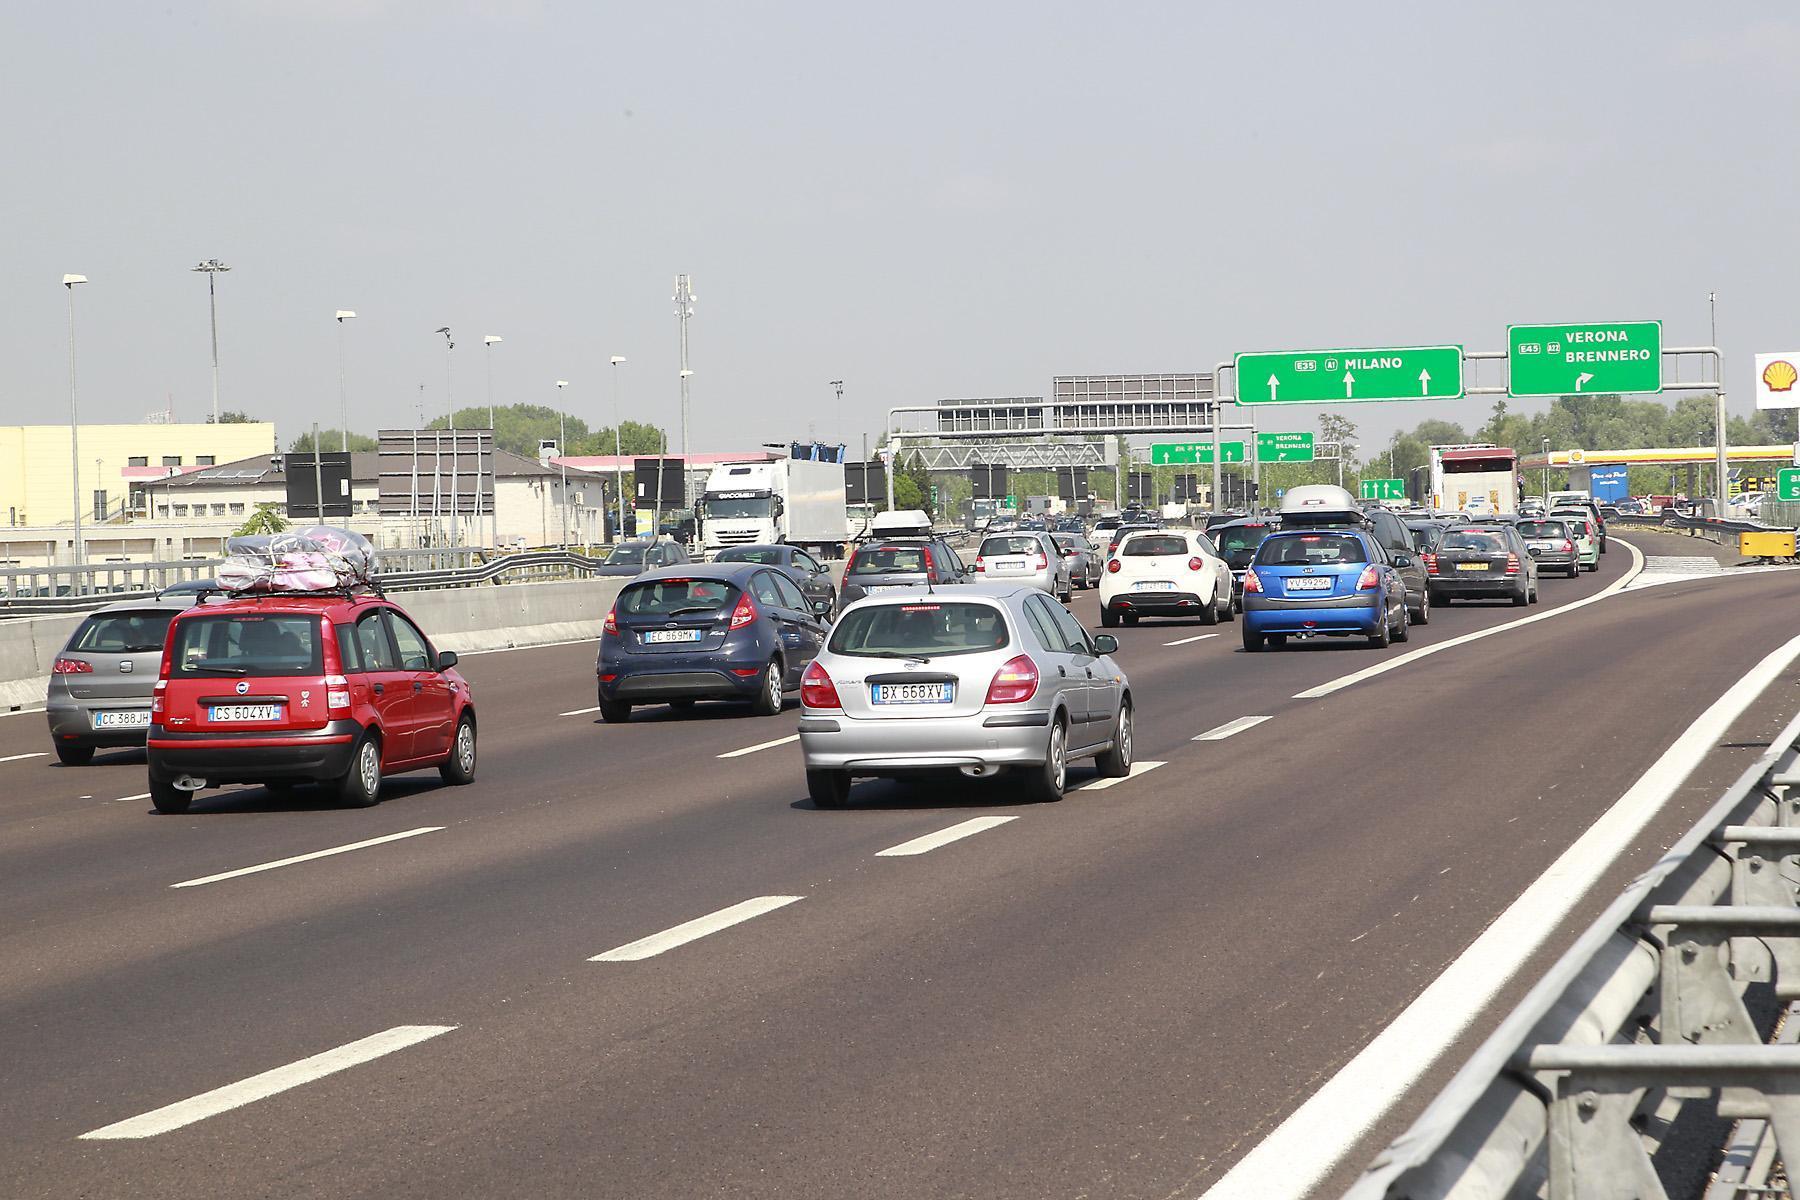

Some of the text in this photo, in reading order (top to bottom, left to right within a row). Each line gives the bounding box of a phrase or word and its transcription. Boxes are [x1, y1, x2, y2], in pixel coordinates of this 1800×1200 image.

[1565, 331, 1628, 343] VERONA
[1520, 345, 1539, 353] E45
[1565, 349, 1651, 363] BRENNERO
[1296, 357, 1403, 370] E35 A1 MILANO
[1302, 578, 1330, 587] 59256
[651, 630, 695, 641] EC 869MK
[881, 684, 943, 700] BX 668XV
[103, 713, 149, 724] CC 388JH
[216, 705, 273, 720] CS 604XV
